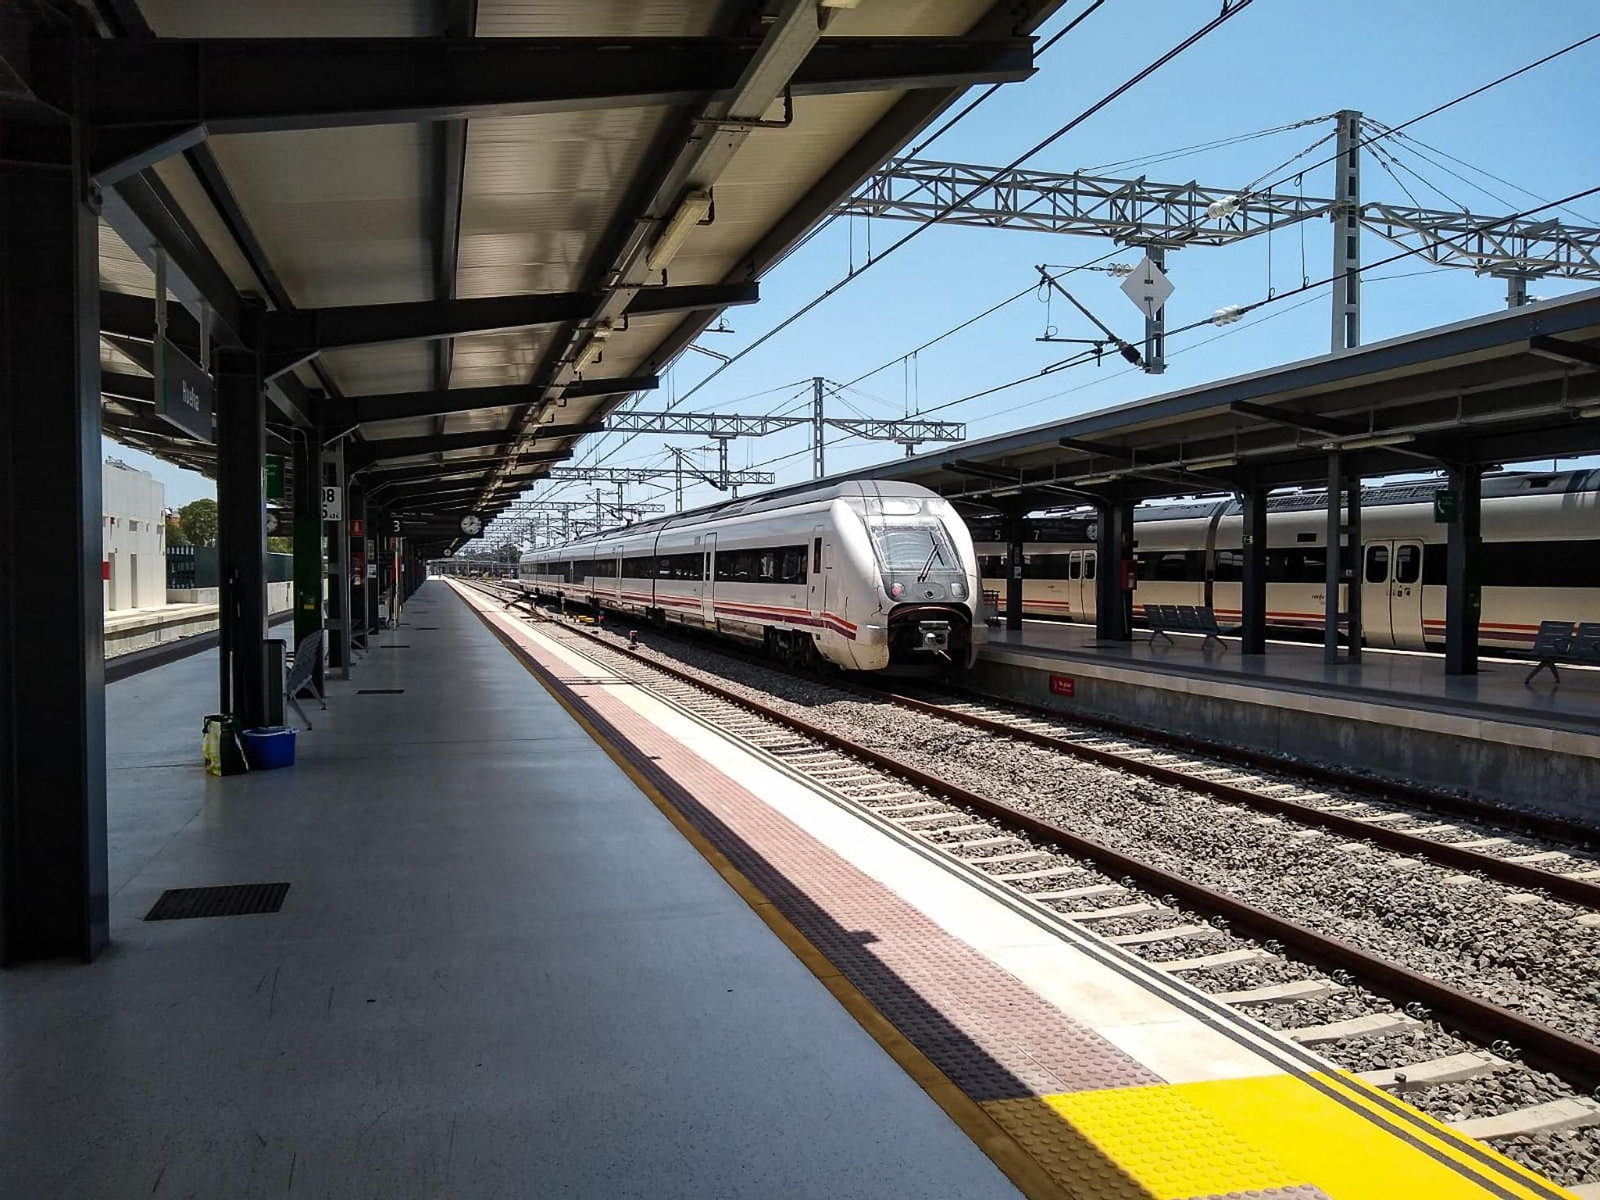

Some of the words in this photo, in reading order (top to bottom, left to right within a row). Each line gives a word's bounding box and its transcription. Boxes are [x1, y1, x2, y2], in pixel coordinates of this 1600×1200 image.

[393, 520, 401, 533] 3
[994, 529, 1001, 541] 5
[1032, 529, 1040, 541] 7
